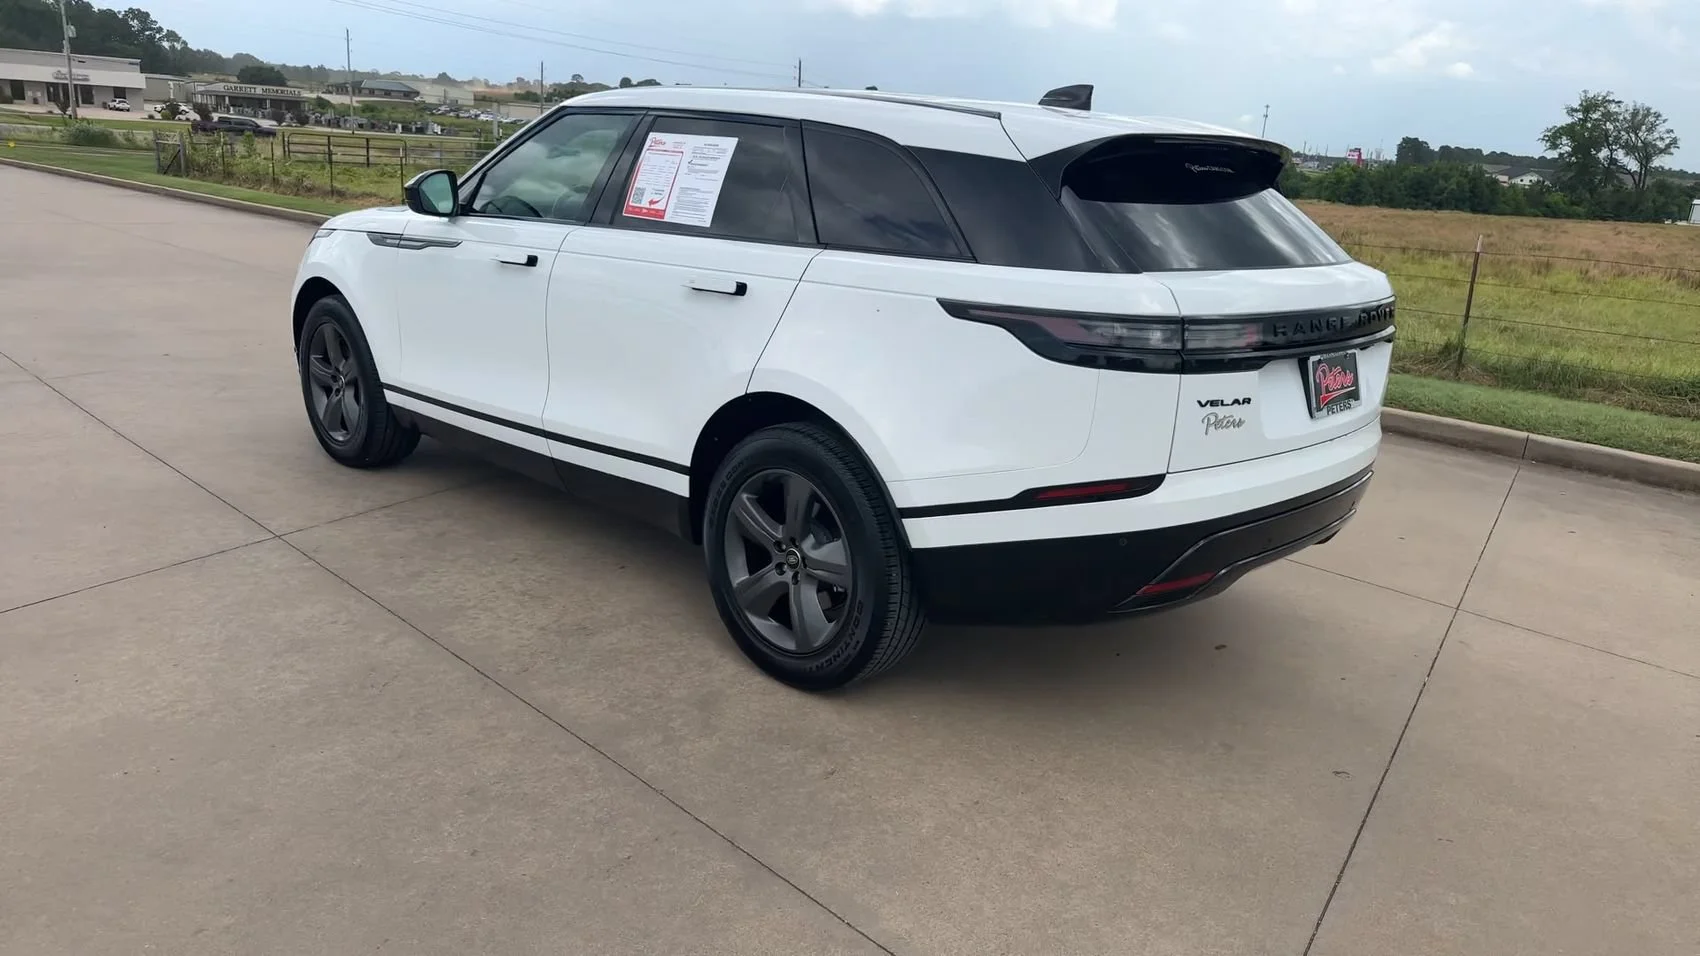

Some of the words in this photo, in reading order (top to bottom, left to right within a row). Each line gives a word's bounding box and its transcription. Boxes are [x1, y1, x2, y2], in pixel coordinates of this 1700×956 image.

[223, 85, 257, 93] GARRETT
[261, 87, 301, 96] MEMORIALS
[1272, 316, 1352, 337] RANGE
[1315, 363, 1354, 393] Peters
[1197, 397, 1252, 408] VELAR
[1326, 399, 1352, 416] PETERS
[1201, 412, 1247, 436] Peters
